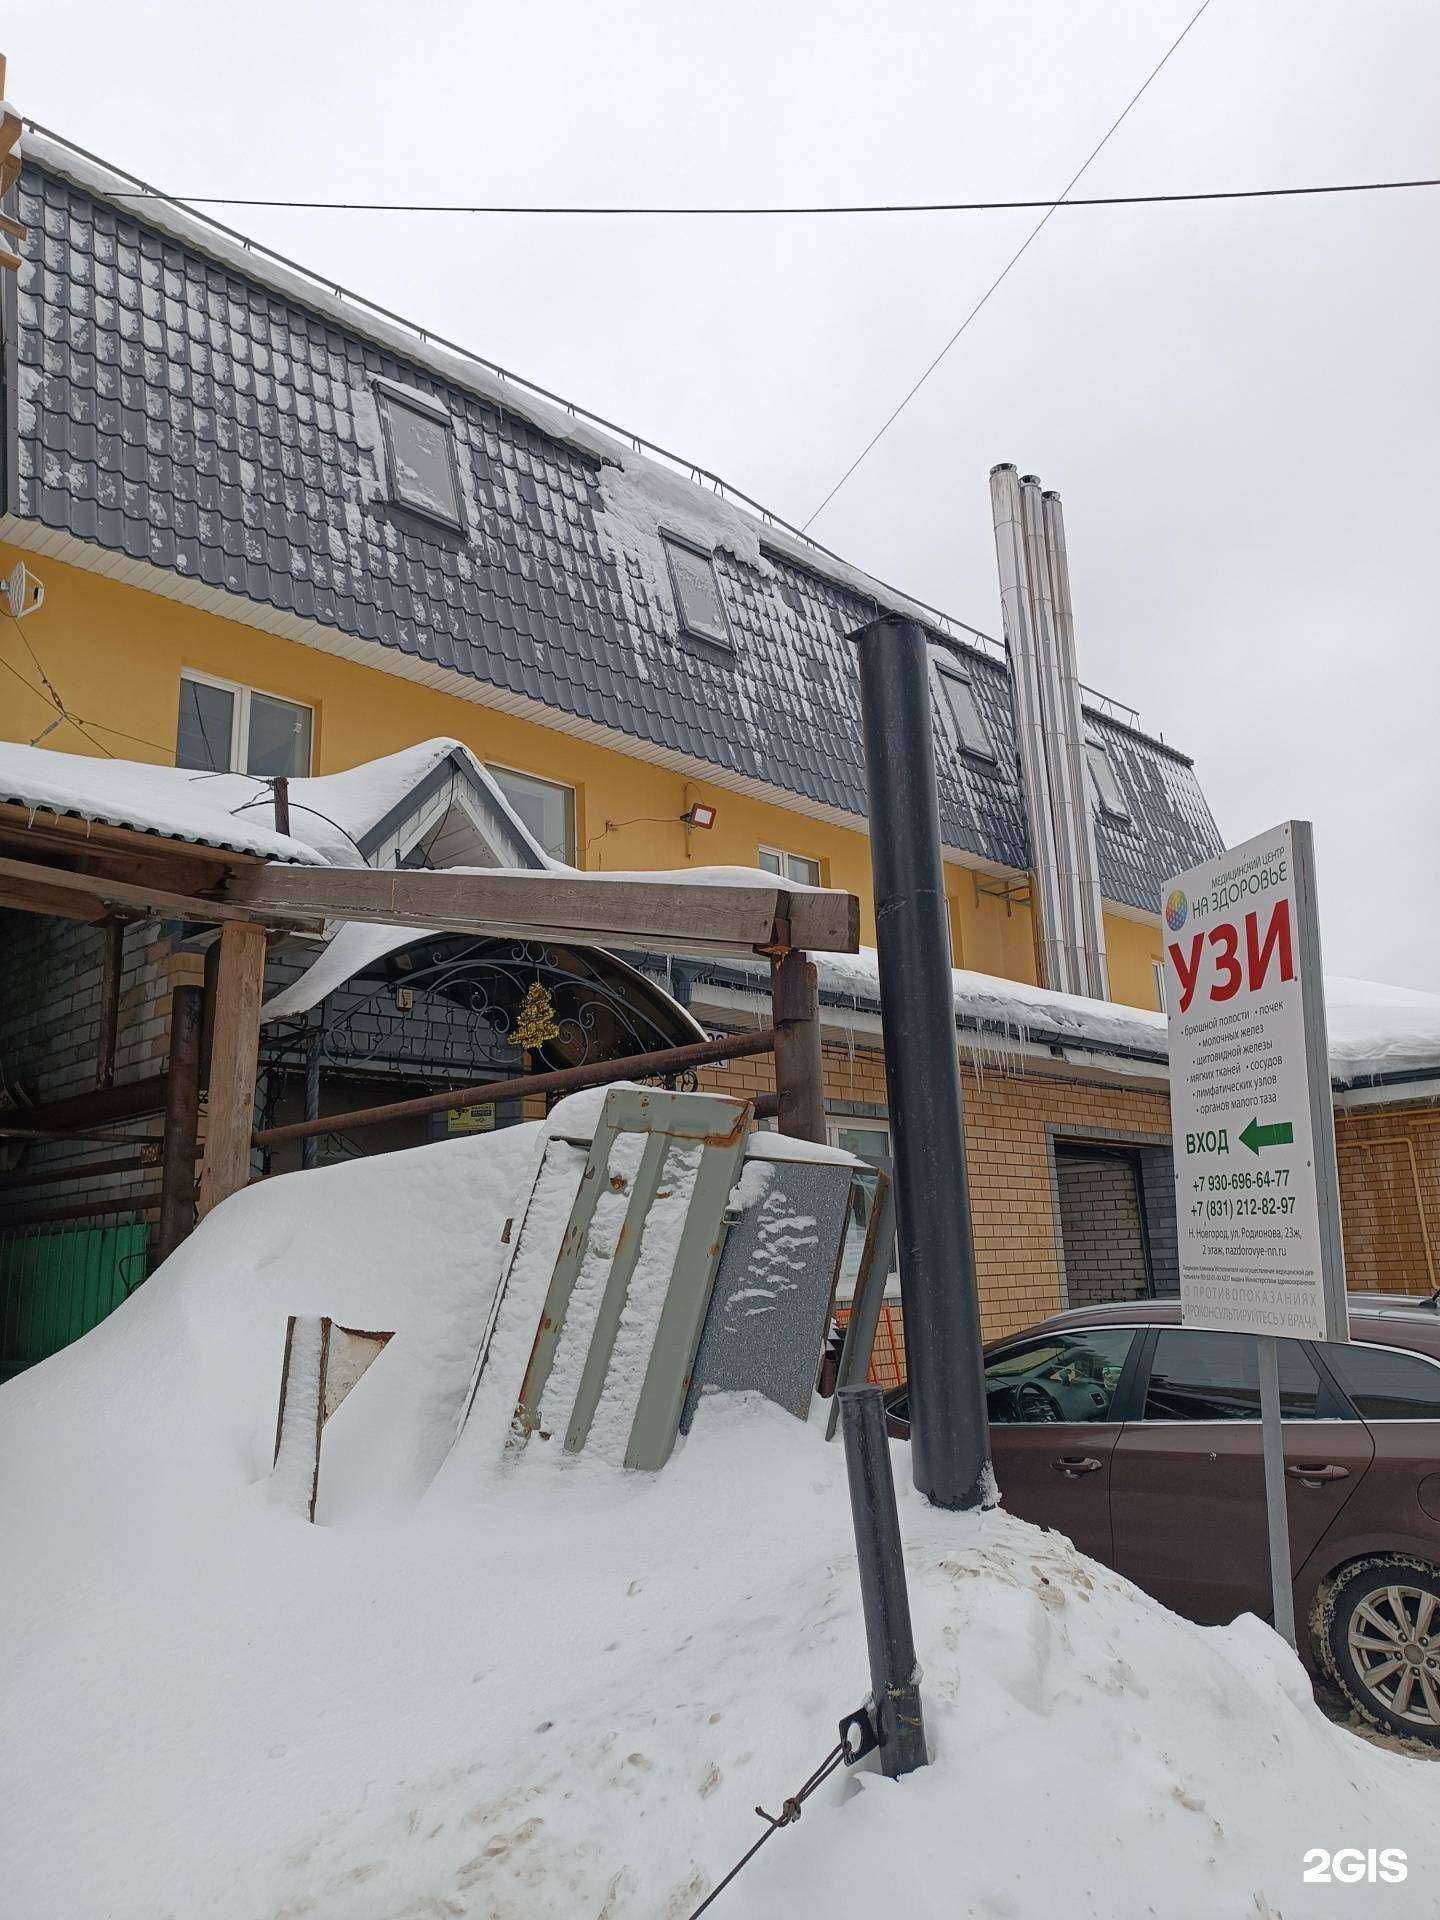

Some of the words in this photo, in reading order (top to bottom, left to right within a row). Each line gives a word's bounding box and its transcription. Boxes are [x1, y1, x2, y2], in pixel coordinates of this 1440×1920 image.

[1211, 857, 1261, 888] МЕДИЦИНСКИЙ
[1262, 847, 1285, 865] ЦЕНТР
[1192, 897, 1209, 919] НА
[1211, 861, 1287, 911] ЗДОРОВЬЕ
[1168, 899, 1294, 1014] УЗИ
[1184, 1018, 1217, 1037] брюшной
[1218, 1010, 1250, 1026] полости
[1259, 1000, 1284, 1016] почек
[1202, 1031, 1239, 1048] молочных
[1240, 1023, 1264, 1038] желез
[1196, 1045, 1241, 1066] щитовидной
[1243, 1039, 1273, 1053] железы
[1190, 1071, 1214, 1084] мягких
[1215, 1063, 1241, 1077] тканей
[1250, 1055, 1283, 1071] сосудов
[1196, 1082, 1252, 1098] лимфатических
[1254, 1074, 1277, 1091] узлов
[1200, 1101, 1229, 1115] органов
[1230, 1097, 1258, 1109] малого
[1259, 1092, 1277, 1105] таза
[1186, 1128, 1230, 1154] ВХОД
[1193, 1176, 1205, 1192] +7
[1208, 1169, 1290, 1192] 930-696-64-77
[1190, 1201, 1203, 1217] +7
[1206, 1198, 1234, 1220] (831)
[1236, 1196, 1296, 1216] 212-82-97
[1188, 1228, 1196, 1238] Н.
[1231, 1228, 1241, 1241] ул.
[1202, 1245, 1207, 1255] 2
[1225, 1245, 1287, 1258] nazdorovye-nn.ru
[1193, 1286, 1317, 1306] ПРОТИВОПОКАЗАНИЯХ
[1287, 1313, 1319, 1329] ВРАЧА
